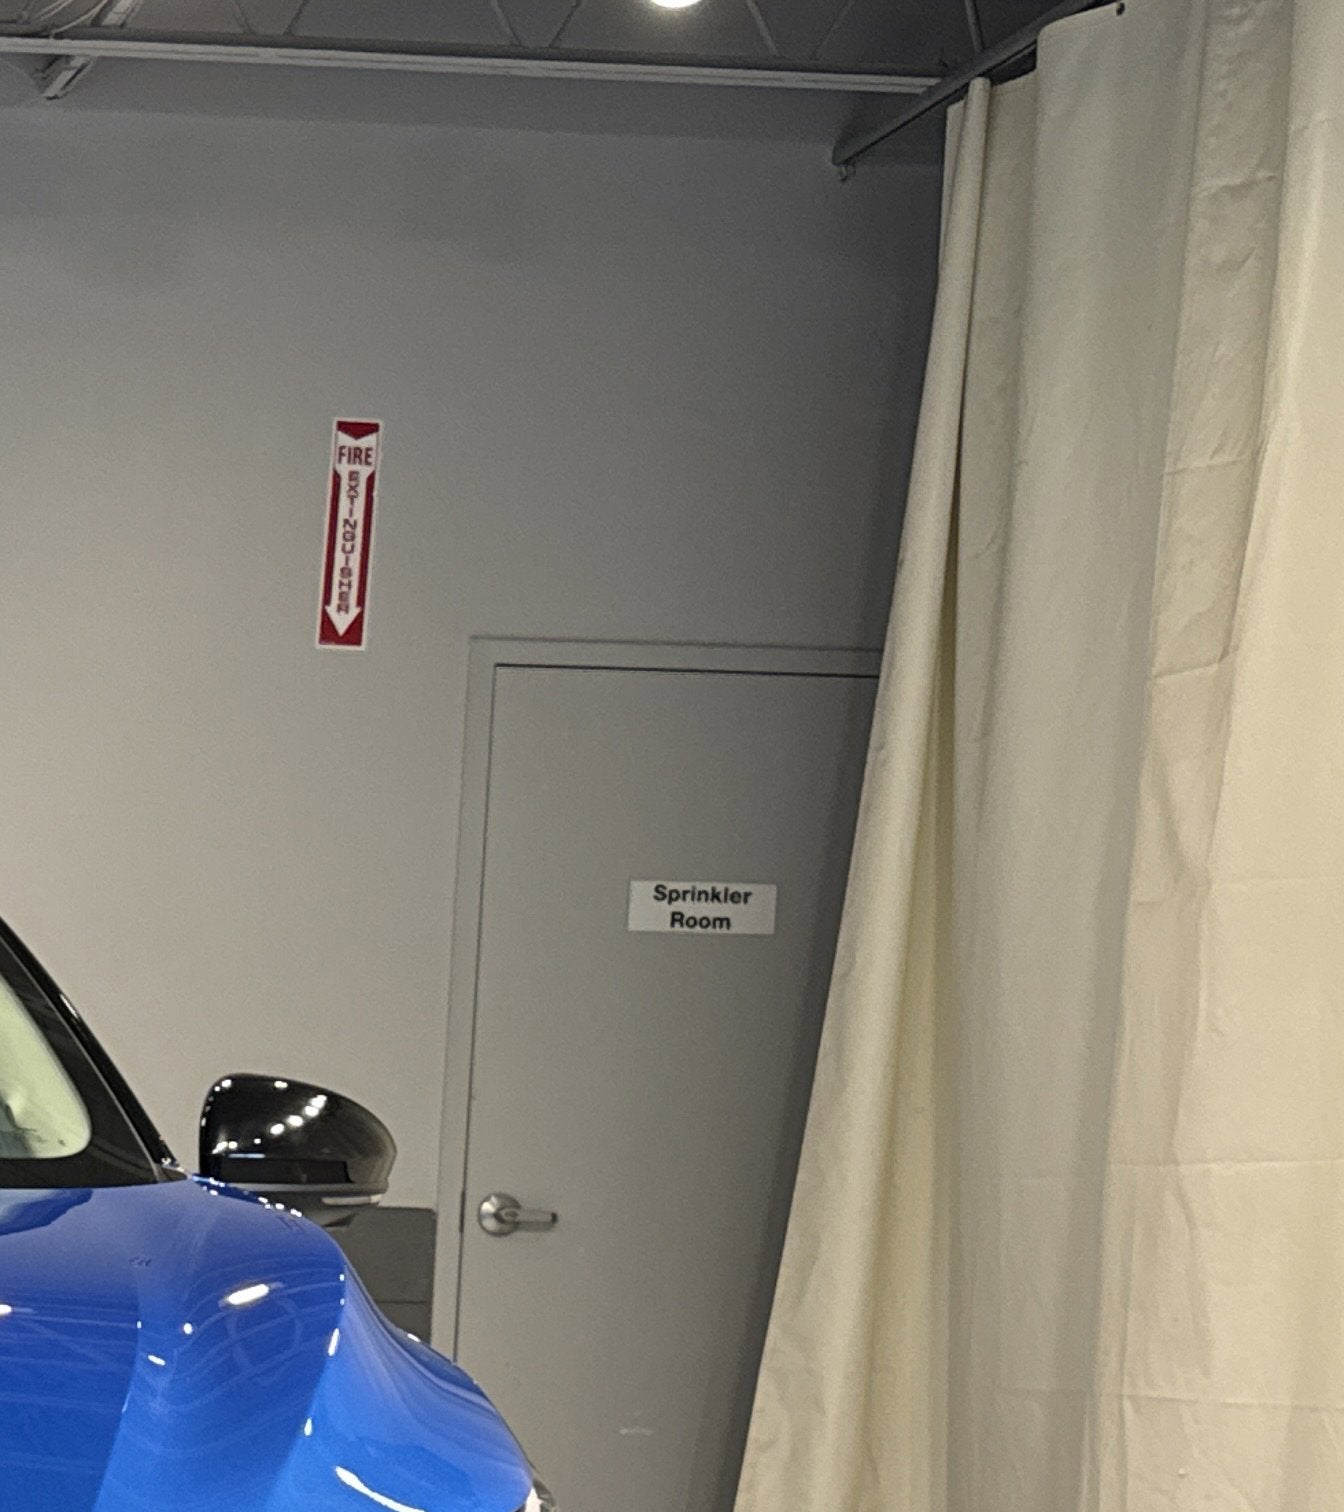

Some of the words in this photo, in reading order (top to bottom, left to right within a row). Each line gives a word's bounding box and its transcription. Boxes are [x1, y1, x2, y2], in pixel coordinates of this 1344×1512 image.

[337, 446, 374, 467] FIRE
[336, 470, 360, 615] EXTINGUISHER
[653, 884, 752, 905] Sprinkler
[670, 911, 731, 930] Room
